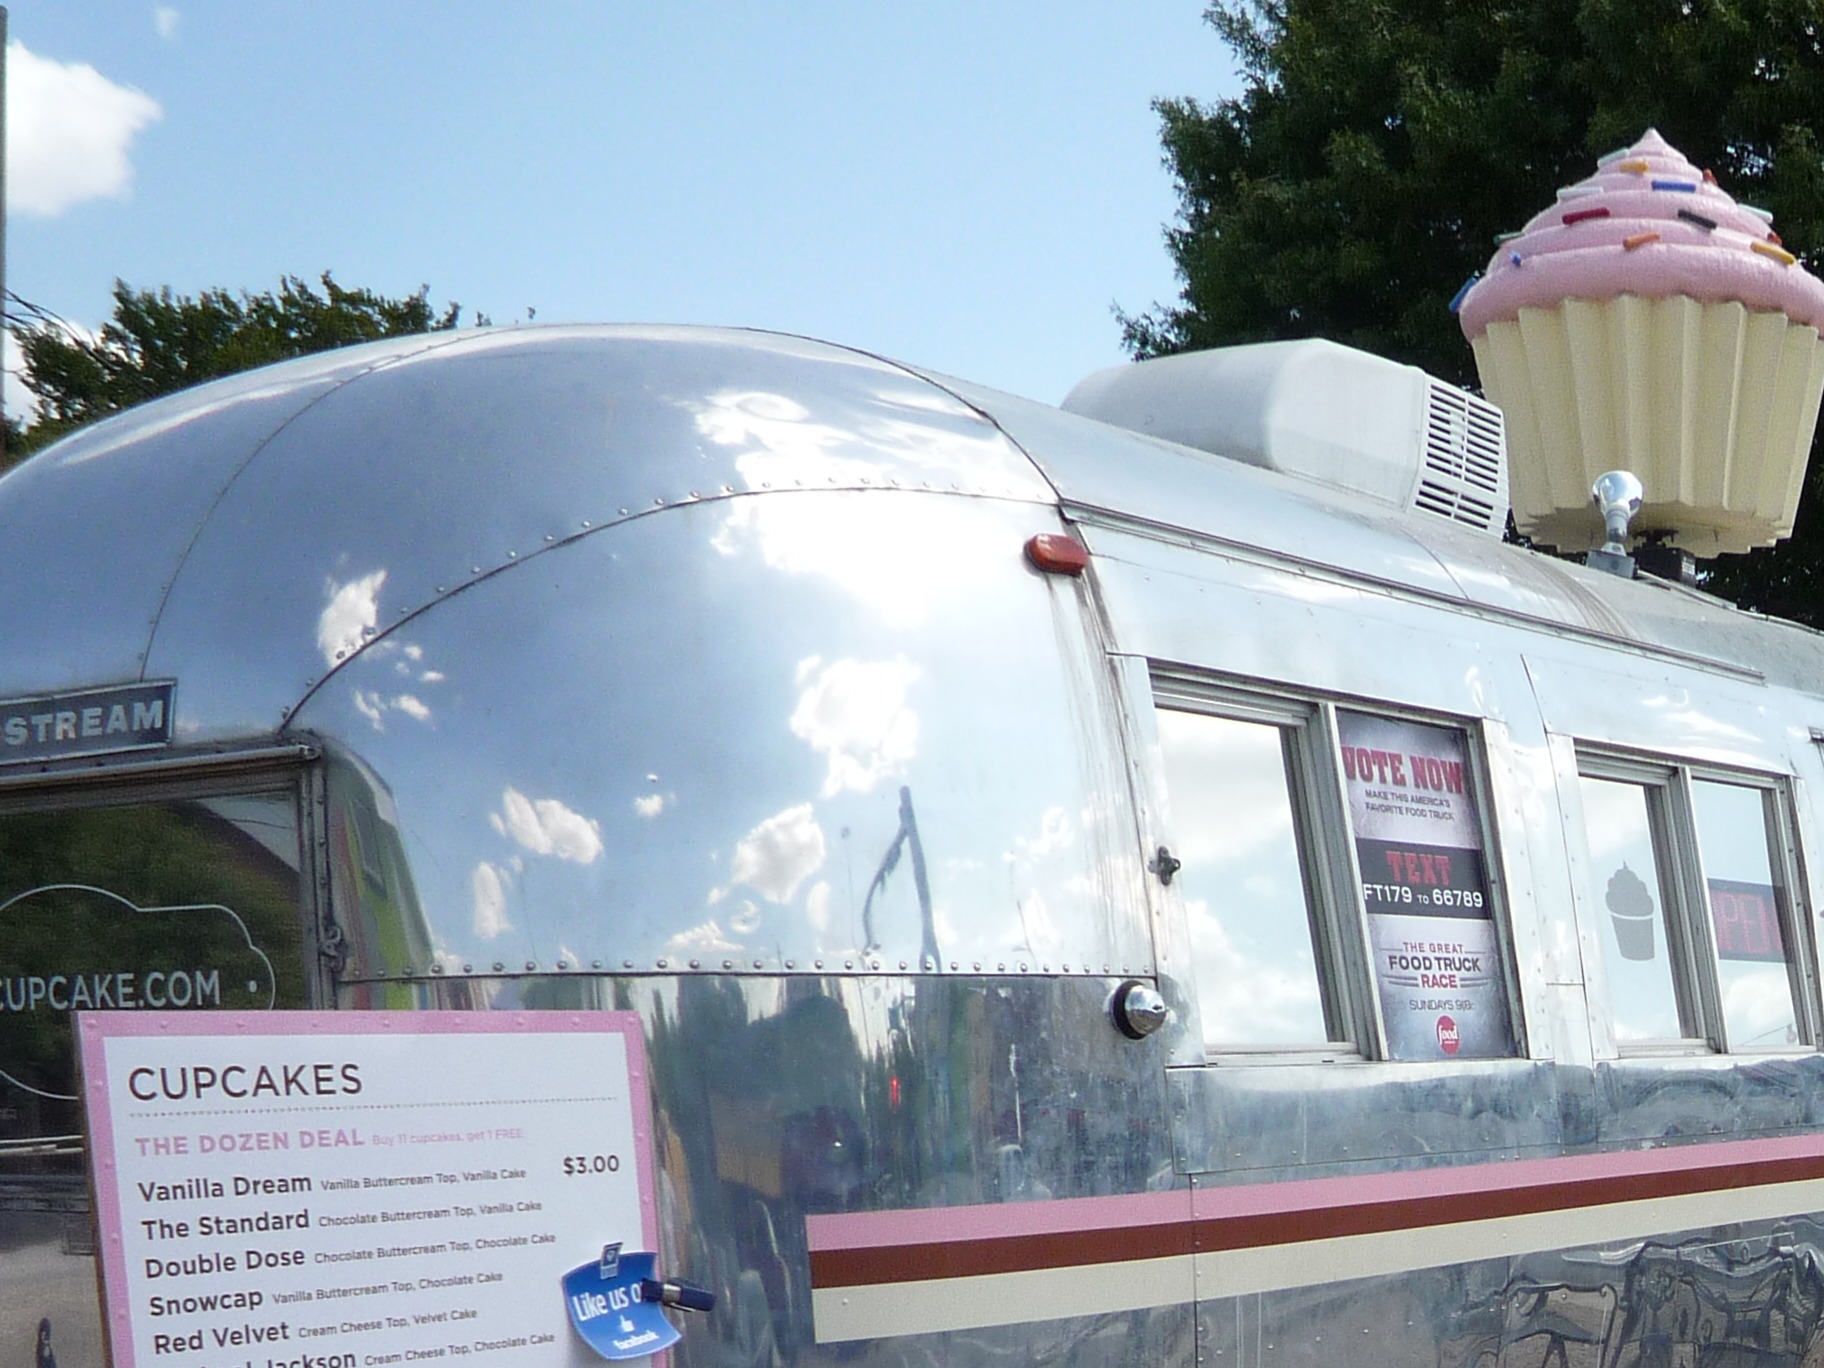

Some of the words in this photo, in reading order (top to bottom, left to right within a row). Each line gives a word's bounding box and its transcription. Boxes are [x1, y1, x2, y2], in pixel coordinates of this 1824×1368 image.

[1341, 746, 1407, 787] VOTE
[1409, 755, 1463, 794] NOW
[1365, 789, 1388, 800] MAKE
[1391, 792, 1409, 803] THIS
[1365, 802, 1404, 815] FAVORITE
[1405, 807, 1427, 818] FOOD
[1428, 810, 1455, 821] TRUCK
[1385, 851, 1451, 886] TEXT
[1363, 883, 1412, 903] FT179
[1417, 894, 1429, 904] TO
[1432, 888, 1483, 908] 66789
[1388, 955, 1433, 971] FOOD
[1433, 956, 1481, 972] TRUCK
[1403, 942, 1426, 953] THE
[1429, 943, 1463, 954] GREAT
[1421, 974, 1458, 989] RACE
[1409, 1000, 1454, 1011] SUNDAYS
[128, 1063, 363, 1101] CUPCAKES
[135, 1136, 189, 1157] THE
[199, 1131, 290, 1154] DOZEN
[300, 1128, 366, 1149] DEAL
[372, 1134, 394, 1147] Buy
[467, 1131, 487, 1144] get
[495, 1128, 523, 1139] FREE
[563, 1154, 620, 1177] $3.00
[137, 1178, 225, 1202] Vanilla
[233, 1176, 312, 1197] Dream
[320, 1178, 360, 1191] Vanilla
[363, 1174, 433, 1188] Buttercream
[462, 1169, 498, 1181] Vanilla
[500, 1168, 526, 1179] Cake
[141, 1219, 190, 1241] The
[199, 1208, 310, 1236] Standard
[318, 1213, 378, 1228] Chocolate
[380, 1207, 451, 1223] Buttercream
[479, 1203, 514, 1215] Vanilla
[516, 1200, 542, 1212] Cake
[144, 1252, 237, 1279] Double
[246, 1248, 306, 1270] Dose
[314, 1248, 373, 1264] Chocolate
[376, 1242, 446, 1258] Buttercream
[475, 1235, 528, 1250] Chocolate
[530, 1232, 556, 1245] Cake
[150, 1290, 263, 1317] Snowcap
[272, 1291, 313, 1305] Vanilla
[316, 1283, 389, 1300] Buttercream
[418, 1275, 474, 1290] Chocolate
[476, 1271, 503, 1284] Cake
[572, 1291, 609, 1322] Like
[609, 1286, 630, 1311] us
[154, 1329, 204, 1354] Red
[212, 1321, 290, 1348] Velvet
[298, 1325, 337, 1339] Cream
[340, 1320, 383, 1334] Cheese
[413, 1312, 448, 1325] Velvet
[450, 1308, 477, 1321] Cake
[364, 1353, 402, 1367] Cream
[404, 1347, 446, 1362] Cheese
[474, 1336, 527, 1352] Chocolate
[529, 1332, 555, 1345] Cake
